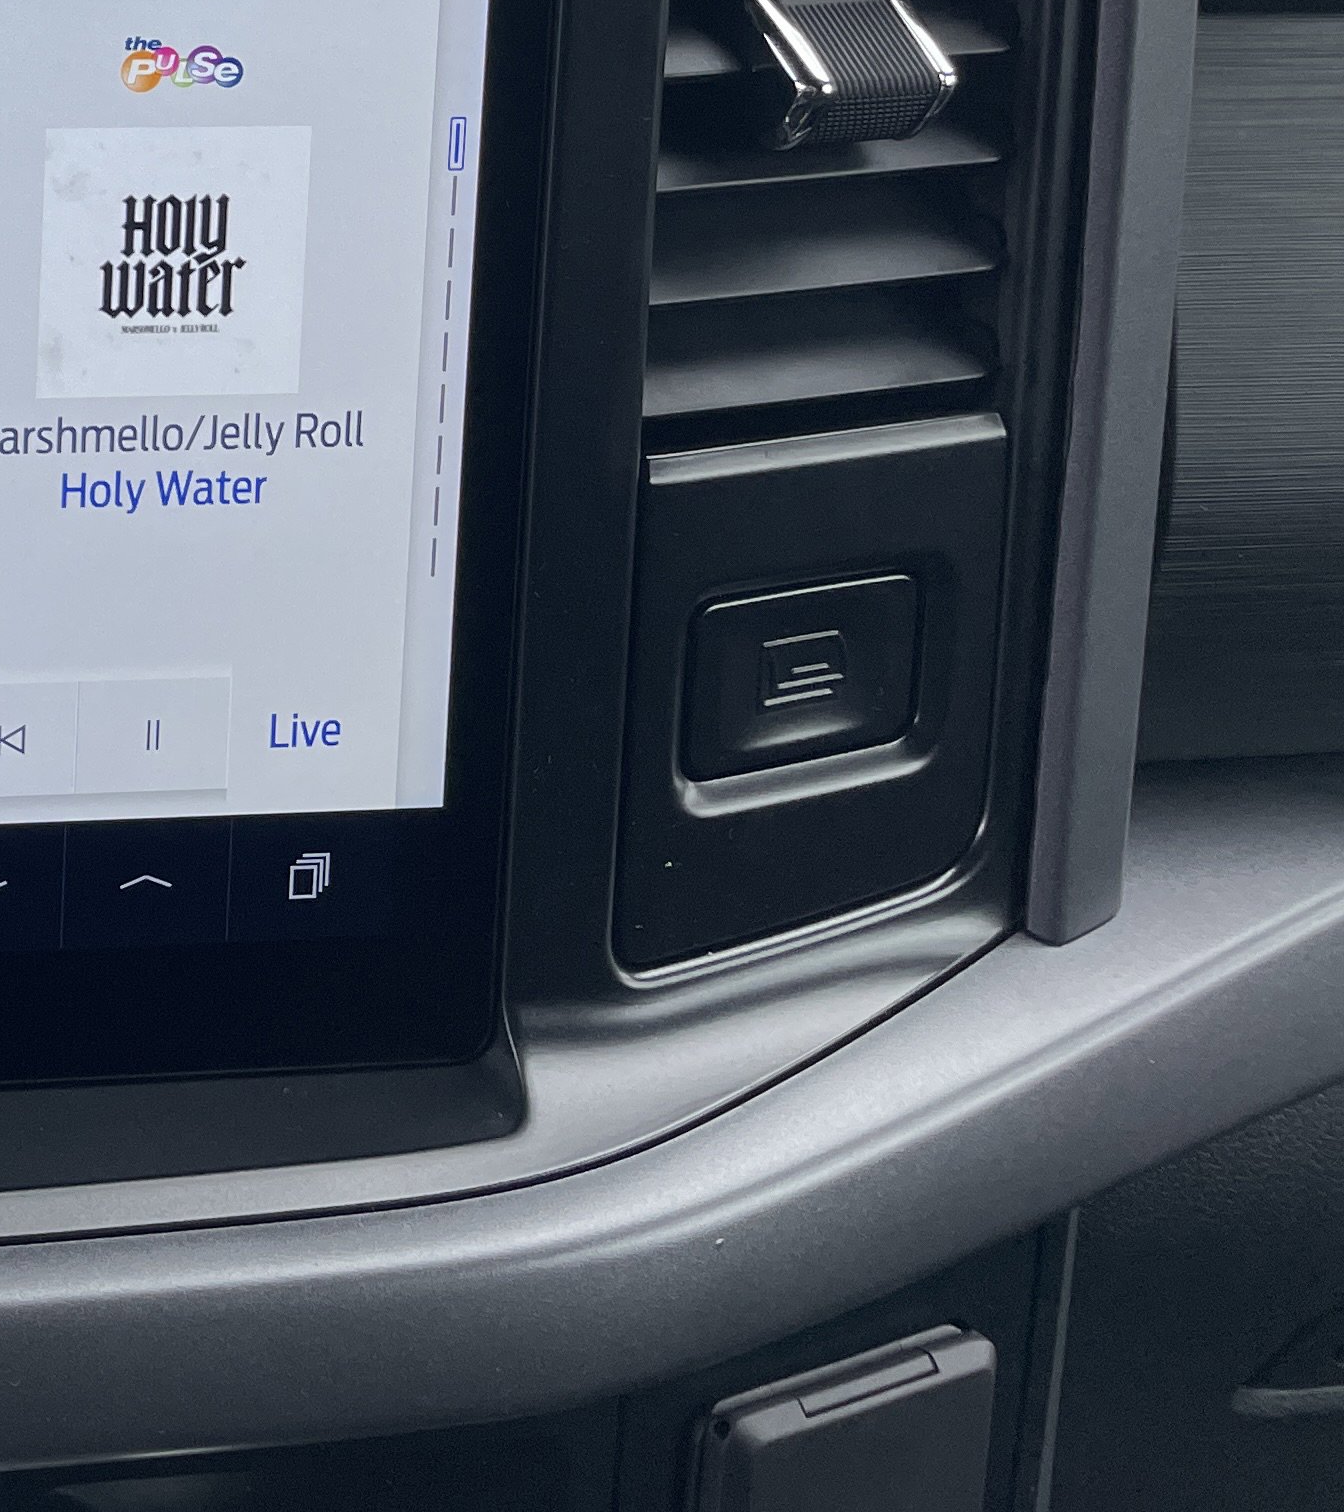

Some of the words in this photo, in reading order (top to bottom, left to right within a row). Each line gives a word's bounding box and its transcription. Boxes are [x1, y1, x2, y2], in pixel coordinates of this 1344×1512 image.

[124, 35, 163, 51] the
[295, 410, 364, 449] Roll
[61, 470, 146, 515] Holy
[155, 469, 268, 507] Water
[269, 712, 341, 749] Live
